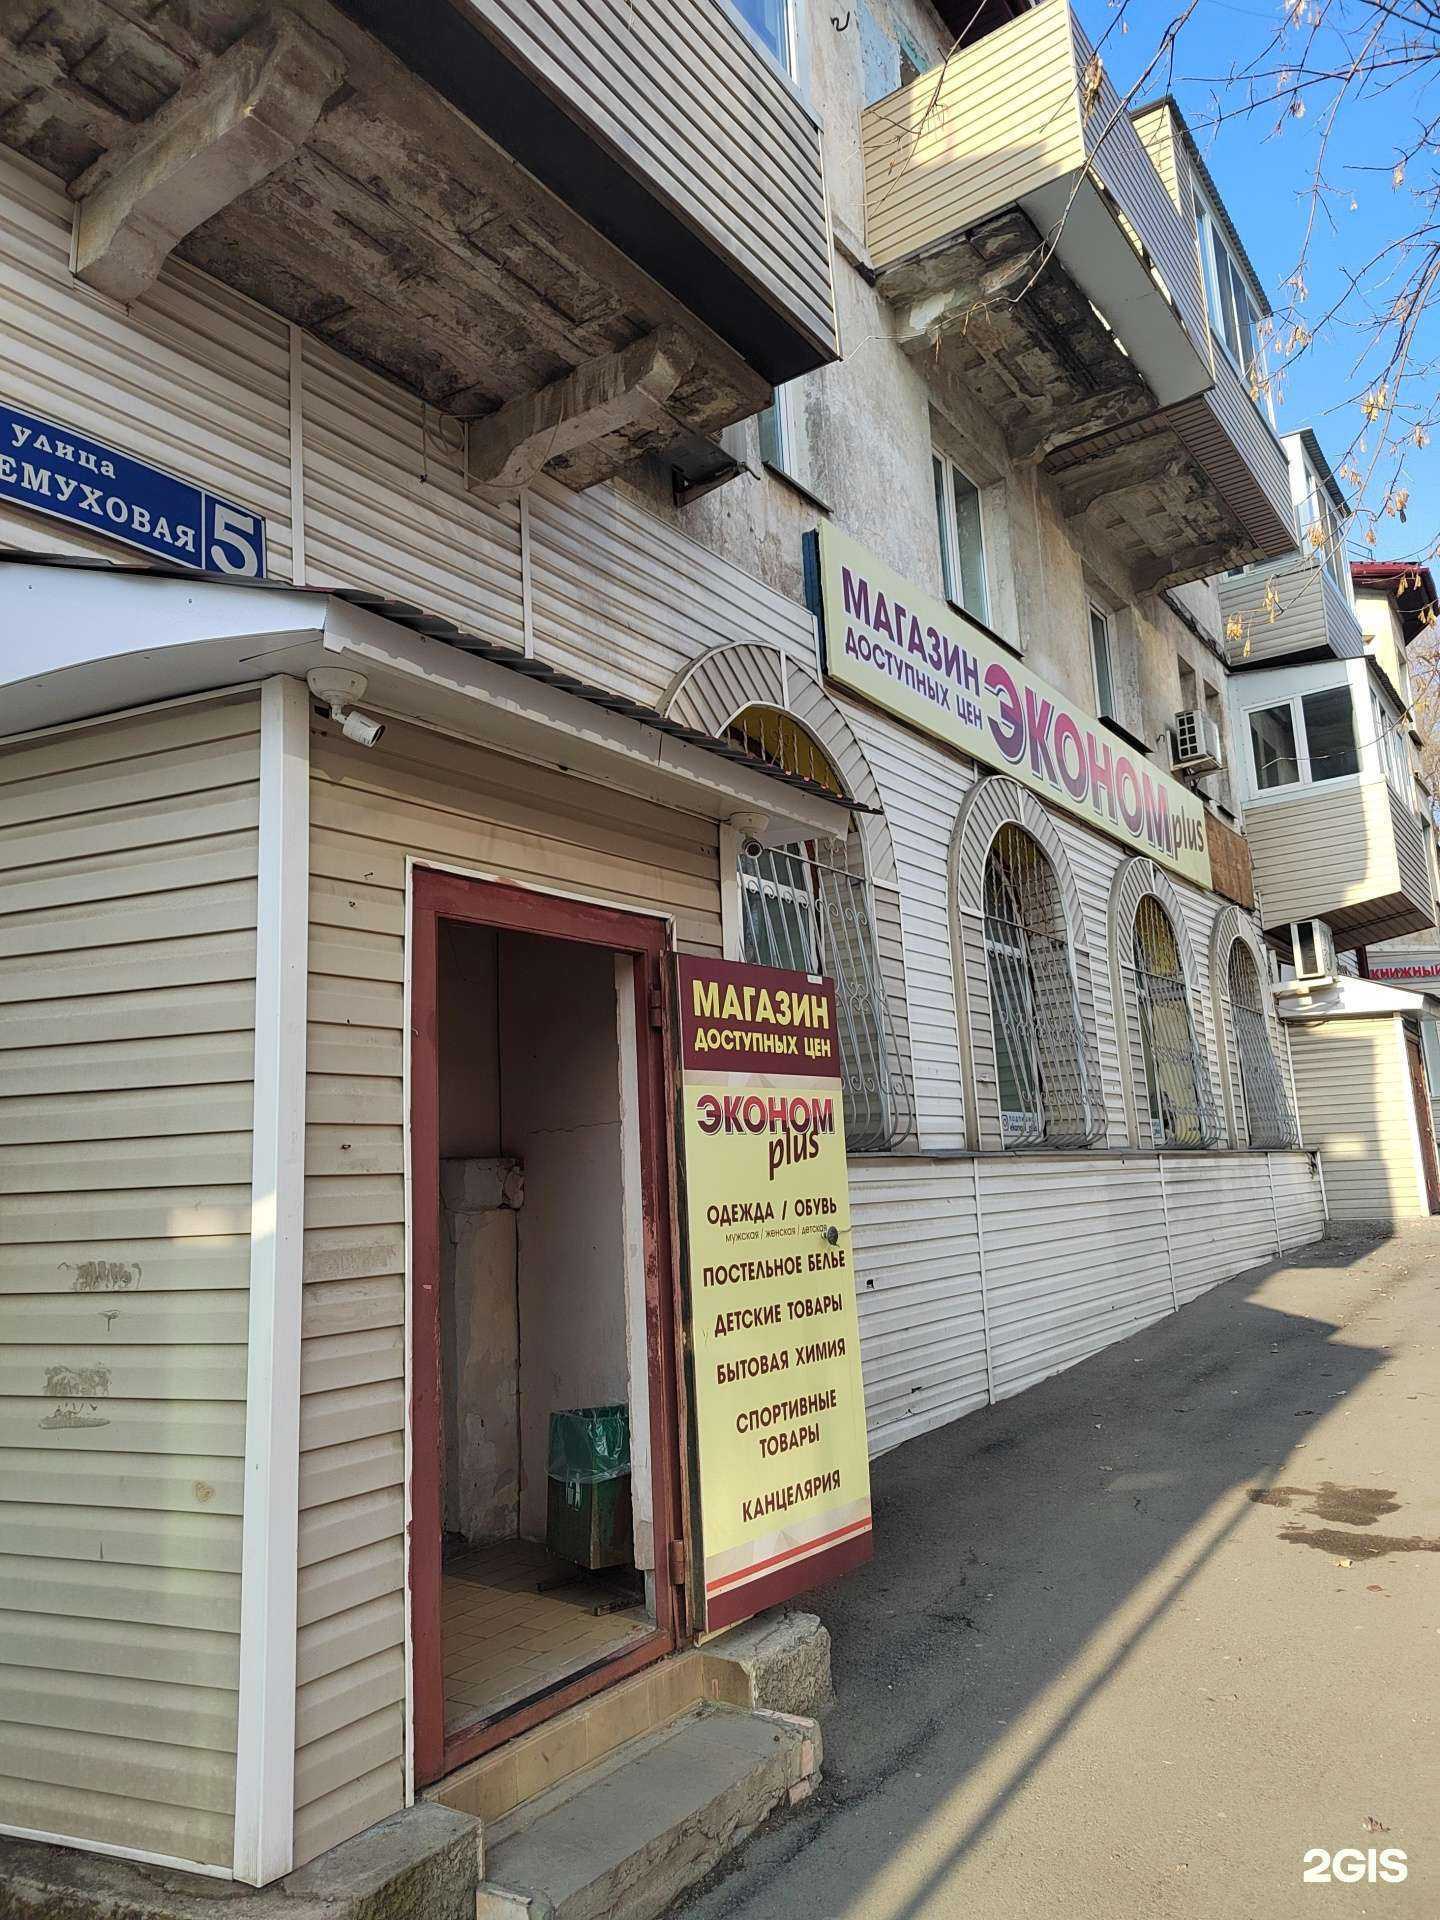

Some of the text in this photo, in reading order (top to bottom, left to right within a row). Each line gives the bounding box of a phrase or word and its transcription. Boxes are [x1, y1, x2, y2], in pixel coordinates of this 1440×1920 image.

[12, 424, 116, 479] улица
[210, 503, 258, 578] 5
[841, 566, 981, 697] МАГАЗИН
[845, 627, 983, 731] ДОСТУПНЫХ ЦЕН
[984, 662, 1173, 855] ЭКОНОМ
[1172, 813, 1205, 861] plus
[692, 979, 830, 1030] МАГАЗИН
[694, 1027, 832, 1060] ДОСТУПНЫХ ЦЕН
[696, 1094, 835, 1135] ЭКОНОМ
[769, 1126, 820, 1181] plus
[707, 1202, 775, 1227] ОДЕЖДА
[794, 1197, 837, 1217] ОБУВЬ
[725, 1230, 760, 1245] мужская
[765, 1227, 796, 1238] женская
[801, 1224, 828, 1236] детская
[703, 1249, 846, 1288] ПОСТЕЛЬНОЕ БЕЛЬЕ
[714, 1294, 843, 1338] ДЕТСКИЕ ТОВАРЫ
[717, 1337, 846, 1385] БЫТОВАЯ ХИМИЯ
[736, 1389, 837, 1434] СПОРТИВНЫЕ
[759, 1423, 820, 1458] ТОВАРЫ
[742, 1469, 841, 1523] КАНЦЕЛЯРИЯ
